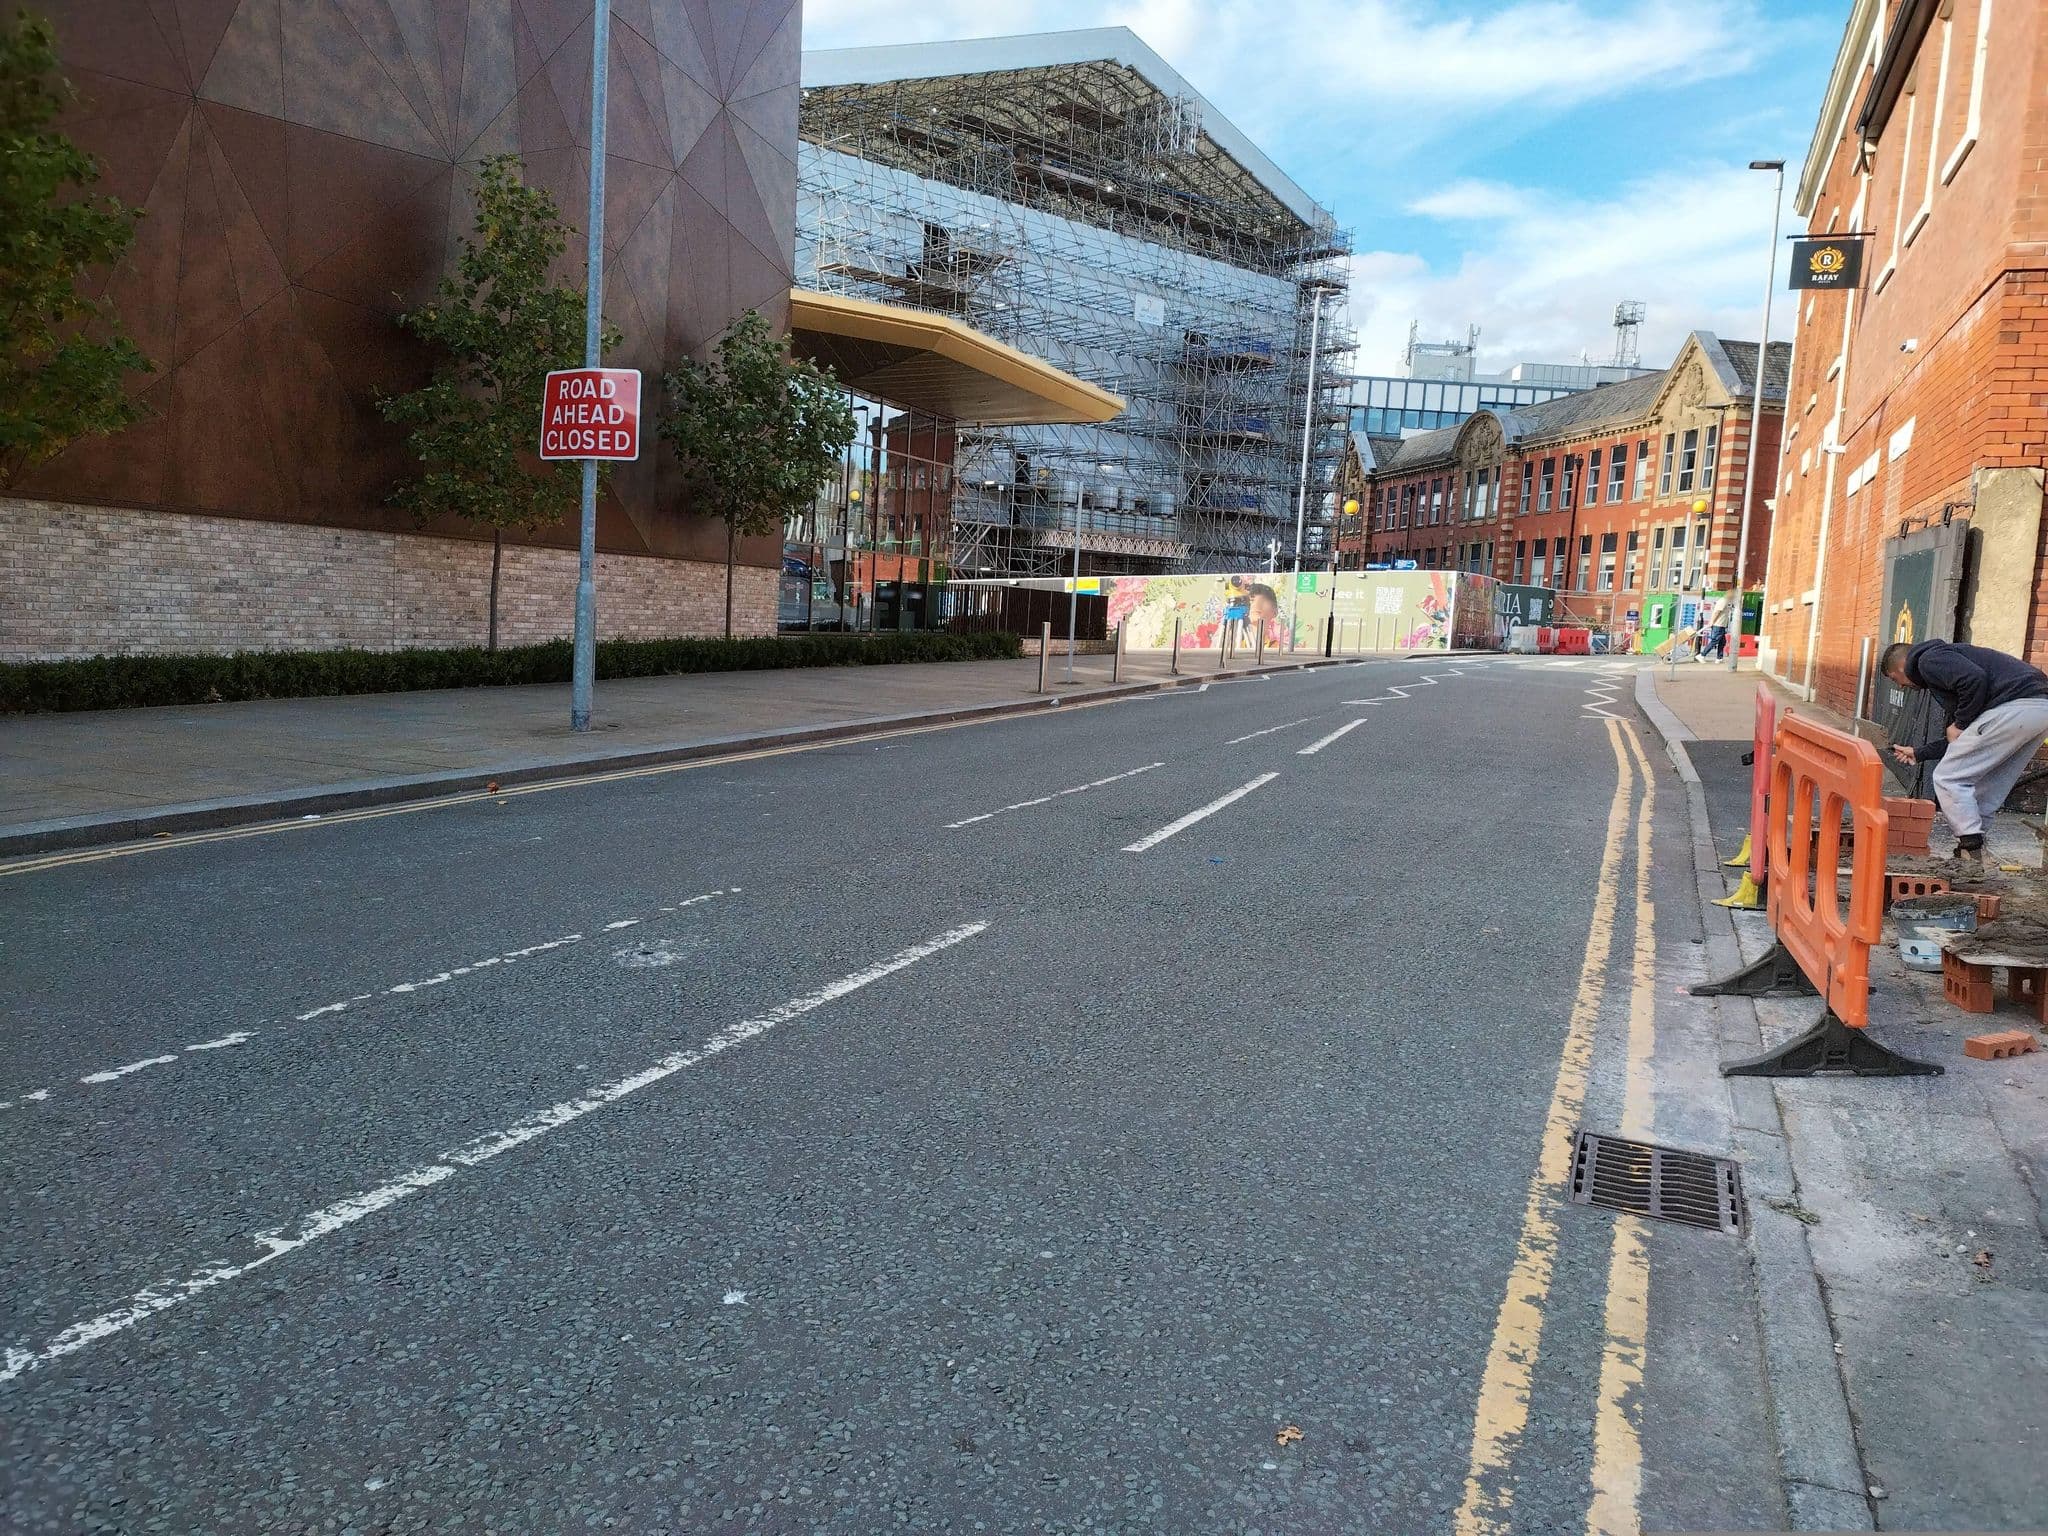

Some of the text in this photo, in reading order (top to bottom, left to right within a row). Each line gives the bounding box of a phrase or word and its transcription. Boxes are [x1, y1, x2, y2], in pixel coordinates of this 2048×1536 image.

[1823, 255, 1832, 265] R
[559, 379, 616, 400] ROAD
[551, 404, 625, 425] AHEAD
[546, 429, 631, 451] CLOSED
